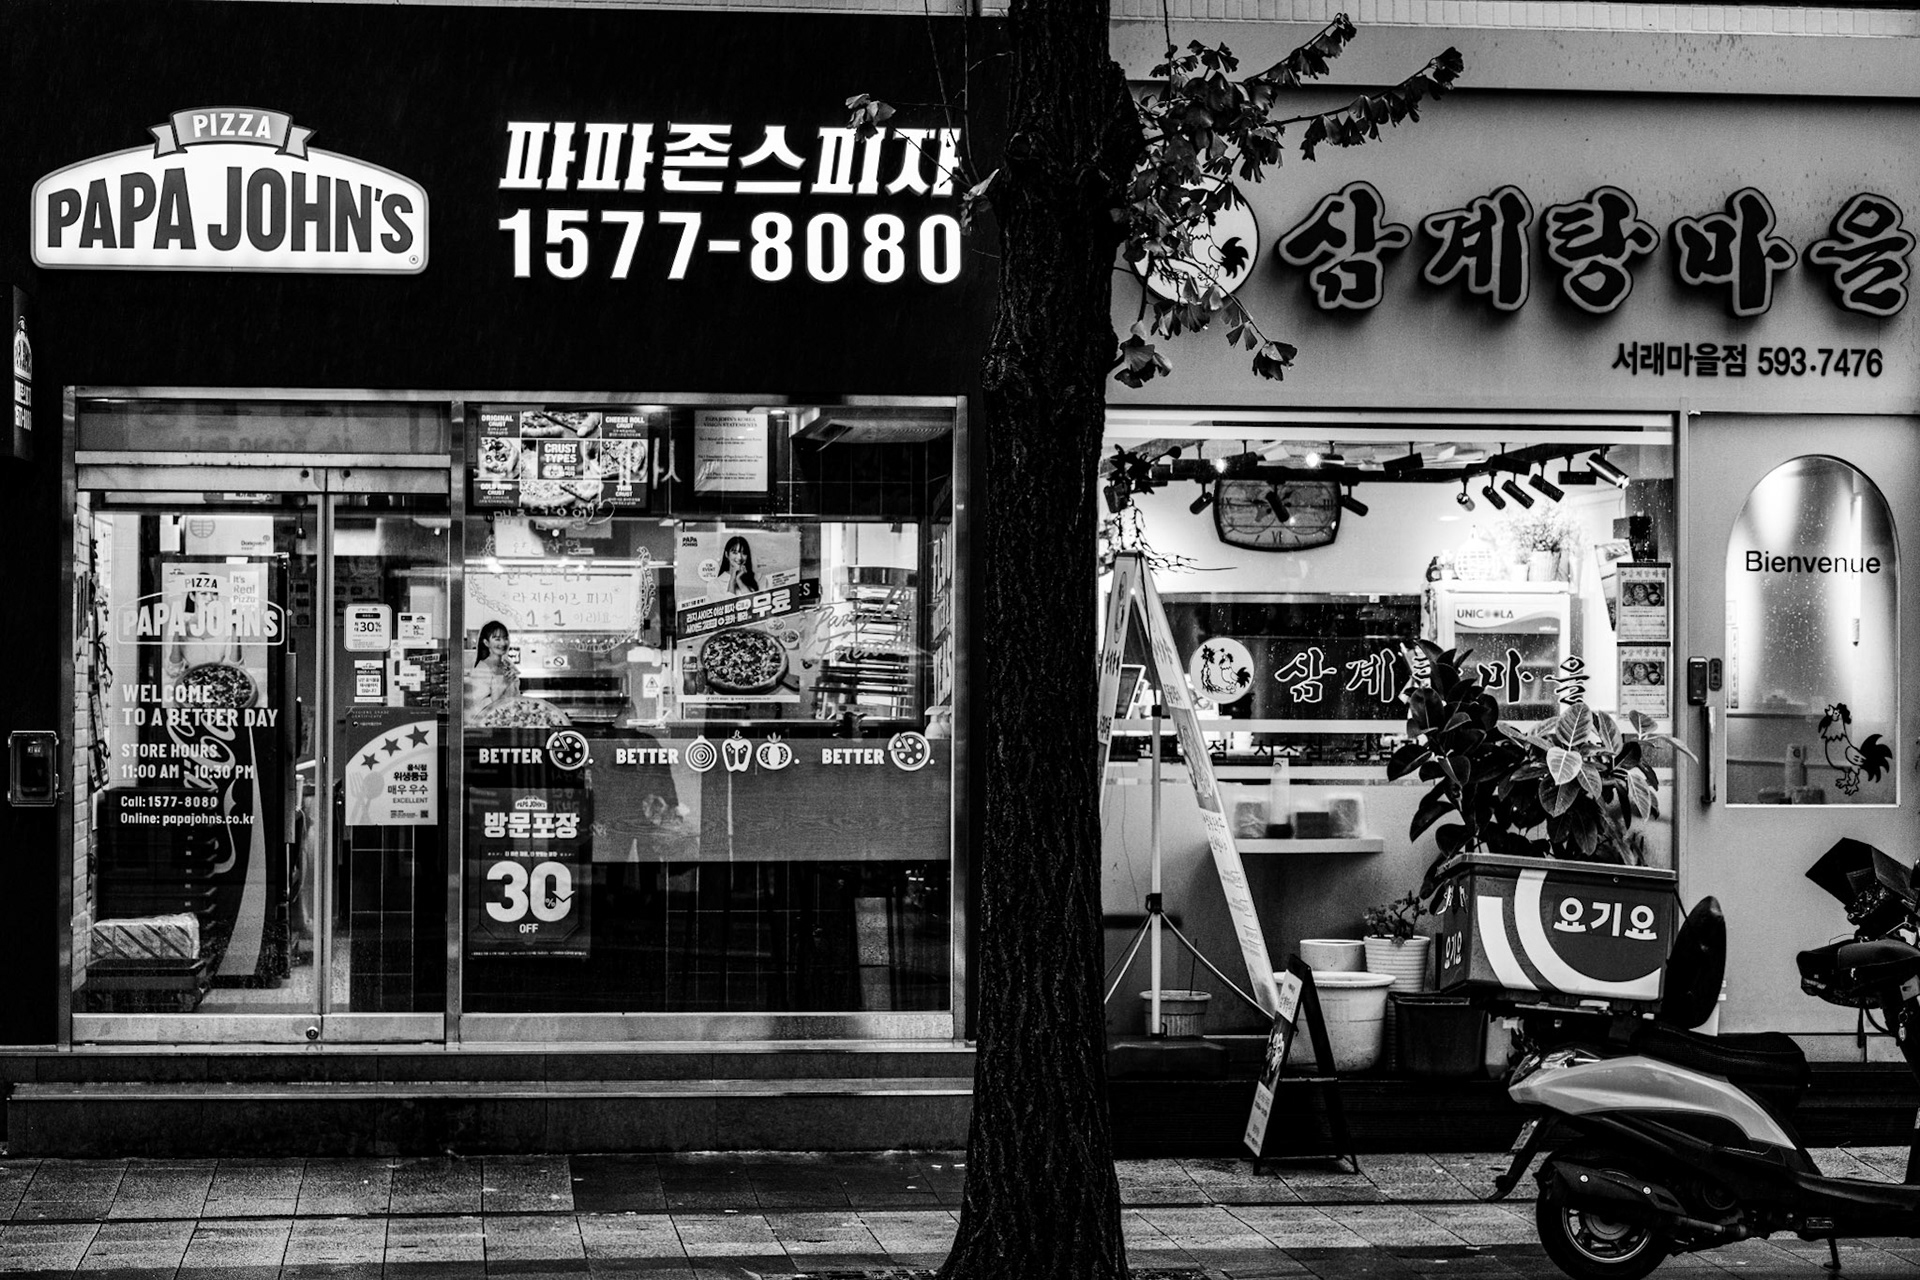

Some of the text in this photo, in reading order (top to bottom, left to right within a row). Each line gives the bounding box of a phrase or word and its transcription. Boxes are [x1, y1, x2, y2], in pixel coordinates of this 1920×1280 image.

[193, 113, 272, 139] PIZZA
[499, 121, 962, 196] 파파존스피자
[48, 166, 414, 254] PAPA JOHN'S
[499, 208, 962, 284] 1577-8080
[1277, 181, 1916, 317] 삼계탕마을
[1612, 341, 1748, 377] 서래마을점
[544, 443, 578, 454] CRUST
[544, 453, 578, 464] TYPES
[1745, 550, 1881, 574] Bienvenue
[185, 577, 218, 589] PIZZA
[234, 575, 245, 584] It's
[233, 585, 256, 594] Real
[752, 588, 791, 618] 무료
[122, 600, 279, 638] PAPA JOHN'S
[122, 684, 214, 703] WELCOME
[122, 707, 278, 727] TO A BETTER DAY
[121, 743, 219, 759] STORE HOURS
[478, 748, 543, 764] BETTER
[616, 748, 679, 765] BETTER
[821, 748, 885, 765] BETTER
[121, 764, 156, 778] 11:00
[159, 765, 180, 779] AM
[193, 765, 232, 779] 10:30
[235, 765, 254, 779] PM
[387, 784, 429, 795] 매우 우수
[121, 796, 218, 808] Call: 1577-8080
[121, 812, 255, 827] Online: papajohns.co.kr
[484, 812, 580, 839] 방문포장
[1553, 896, 1658, 941] 요기요
[519, 923, 539, 934] OFF
[1444, 930, 1463, 970] 요기요
